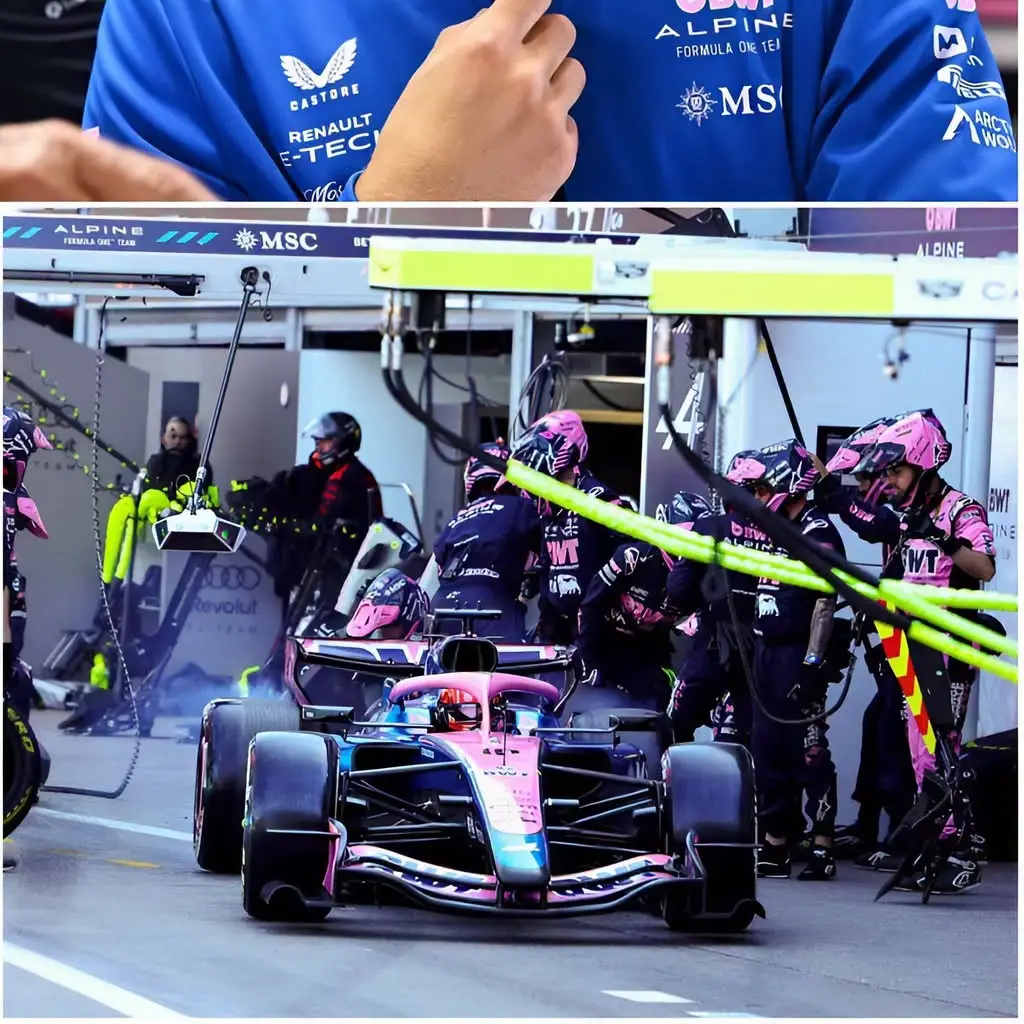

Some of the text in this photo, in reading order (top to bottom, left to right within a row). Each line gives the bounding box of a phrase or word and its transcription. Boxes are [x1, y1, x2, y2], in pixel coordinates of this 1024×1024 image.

[655, 12, 794, 40] ALPINE
[676, 42, 734, 59] FORMULA
[290, 83, 360, 112] CASTORE
[288, 112, 373, 144] RENAULT
[54, 224, 144, 236] ALPINE
[259, 231, 319, 251] MSC
